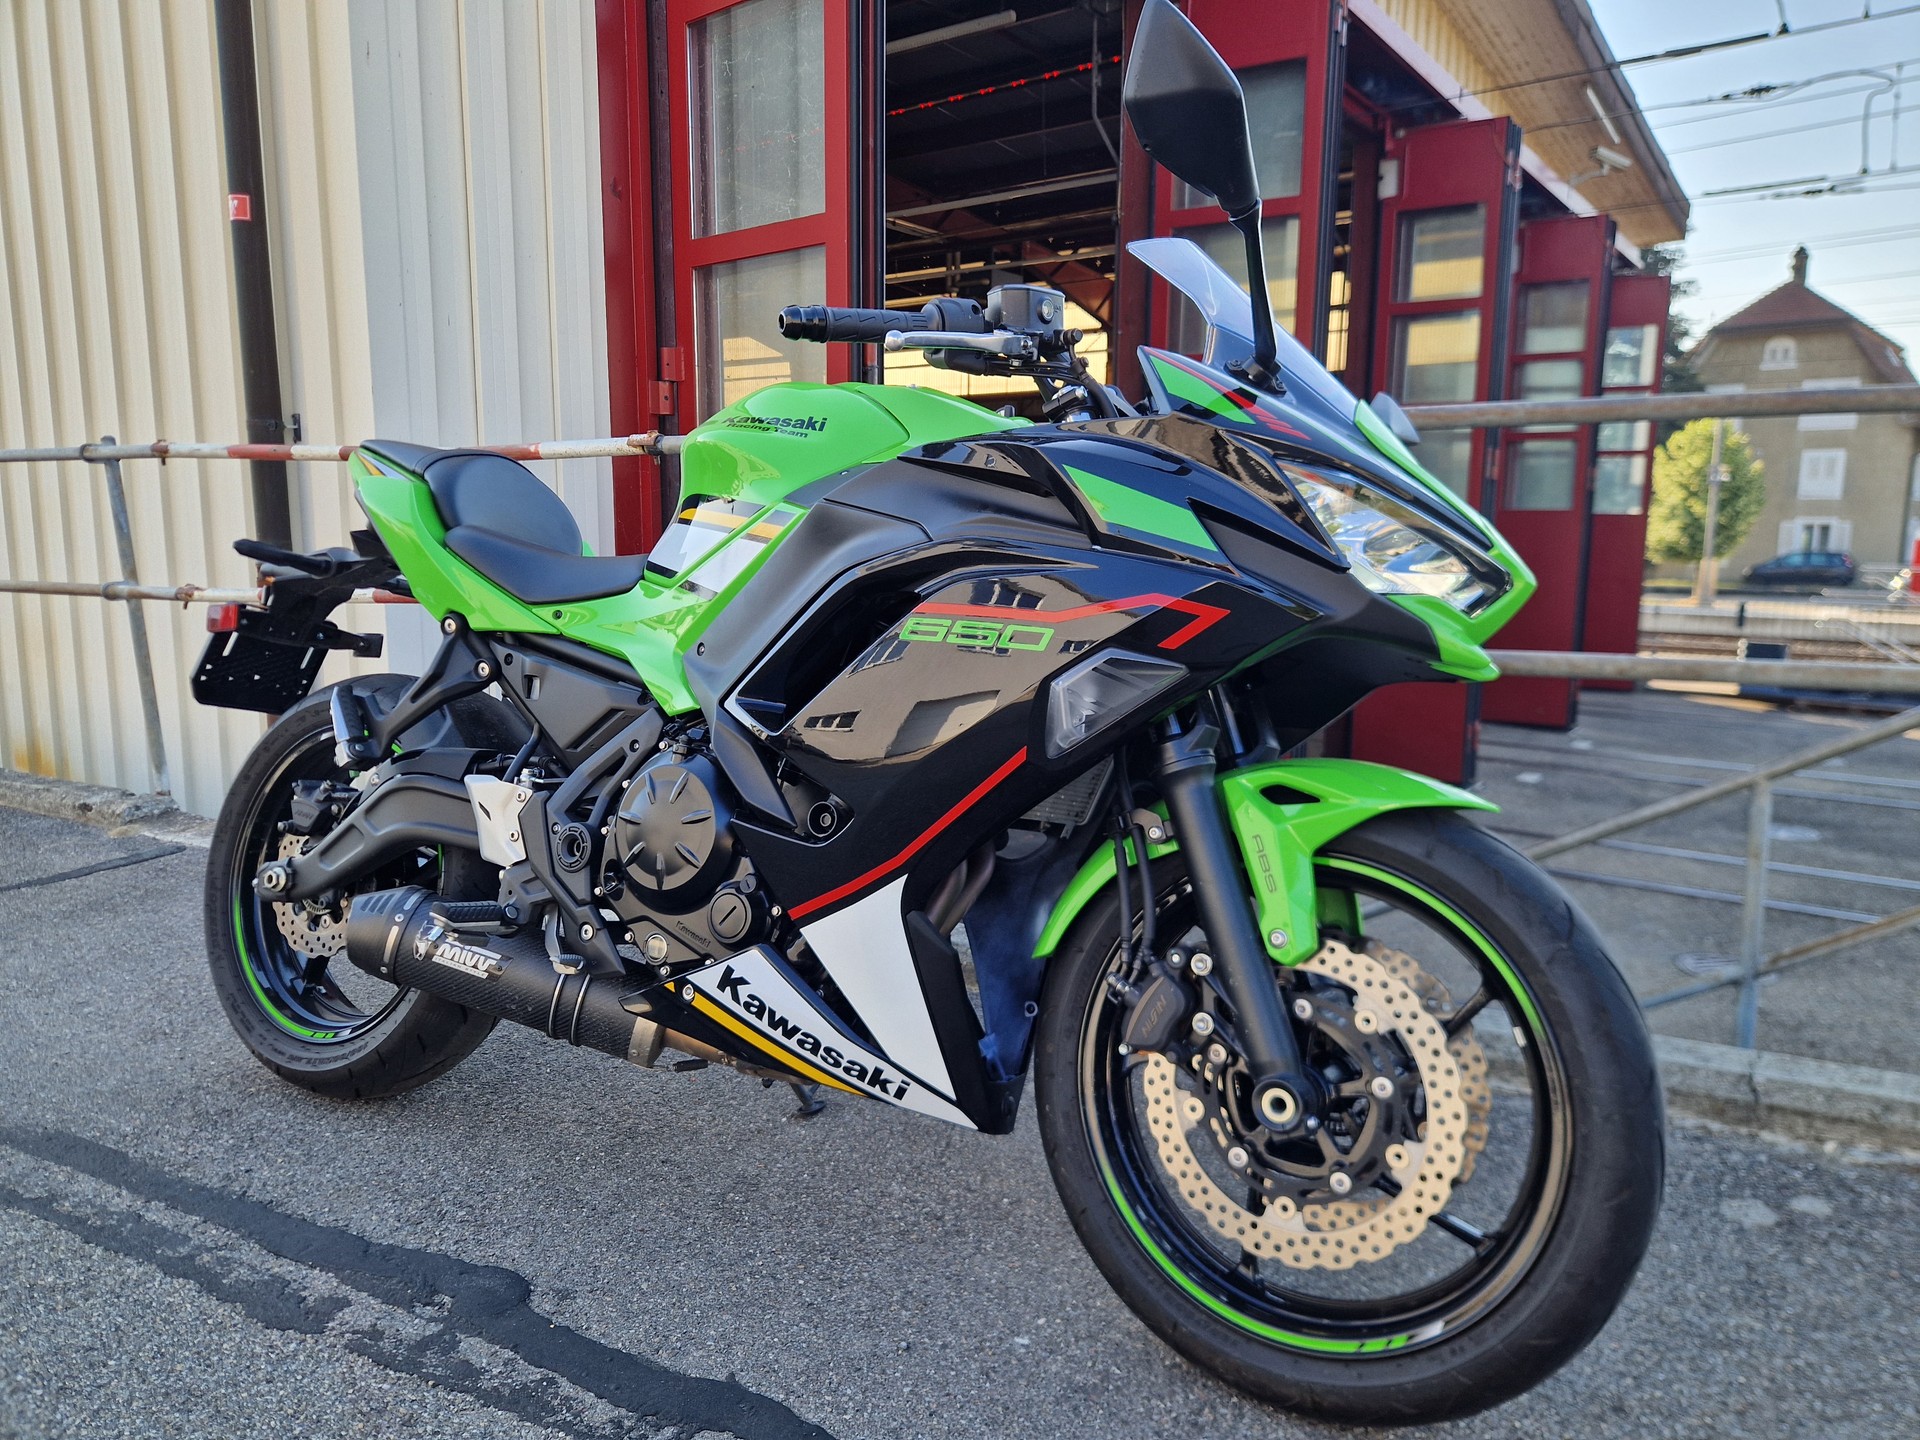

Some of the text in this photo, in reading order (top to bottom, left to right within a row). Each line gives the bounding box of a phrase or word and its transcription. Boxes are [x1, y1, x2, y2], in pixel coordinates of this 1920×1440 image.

[722, 415, 828, 432] Kawasaki
[726, 423, 809, 438] Racing Team
[898, 617, 1055, 652] 650
[1252, 834, 1277, 893] ABS
[716, 964, 911, 1101] Kawasaki
